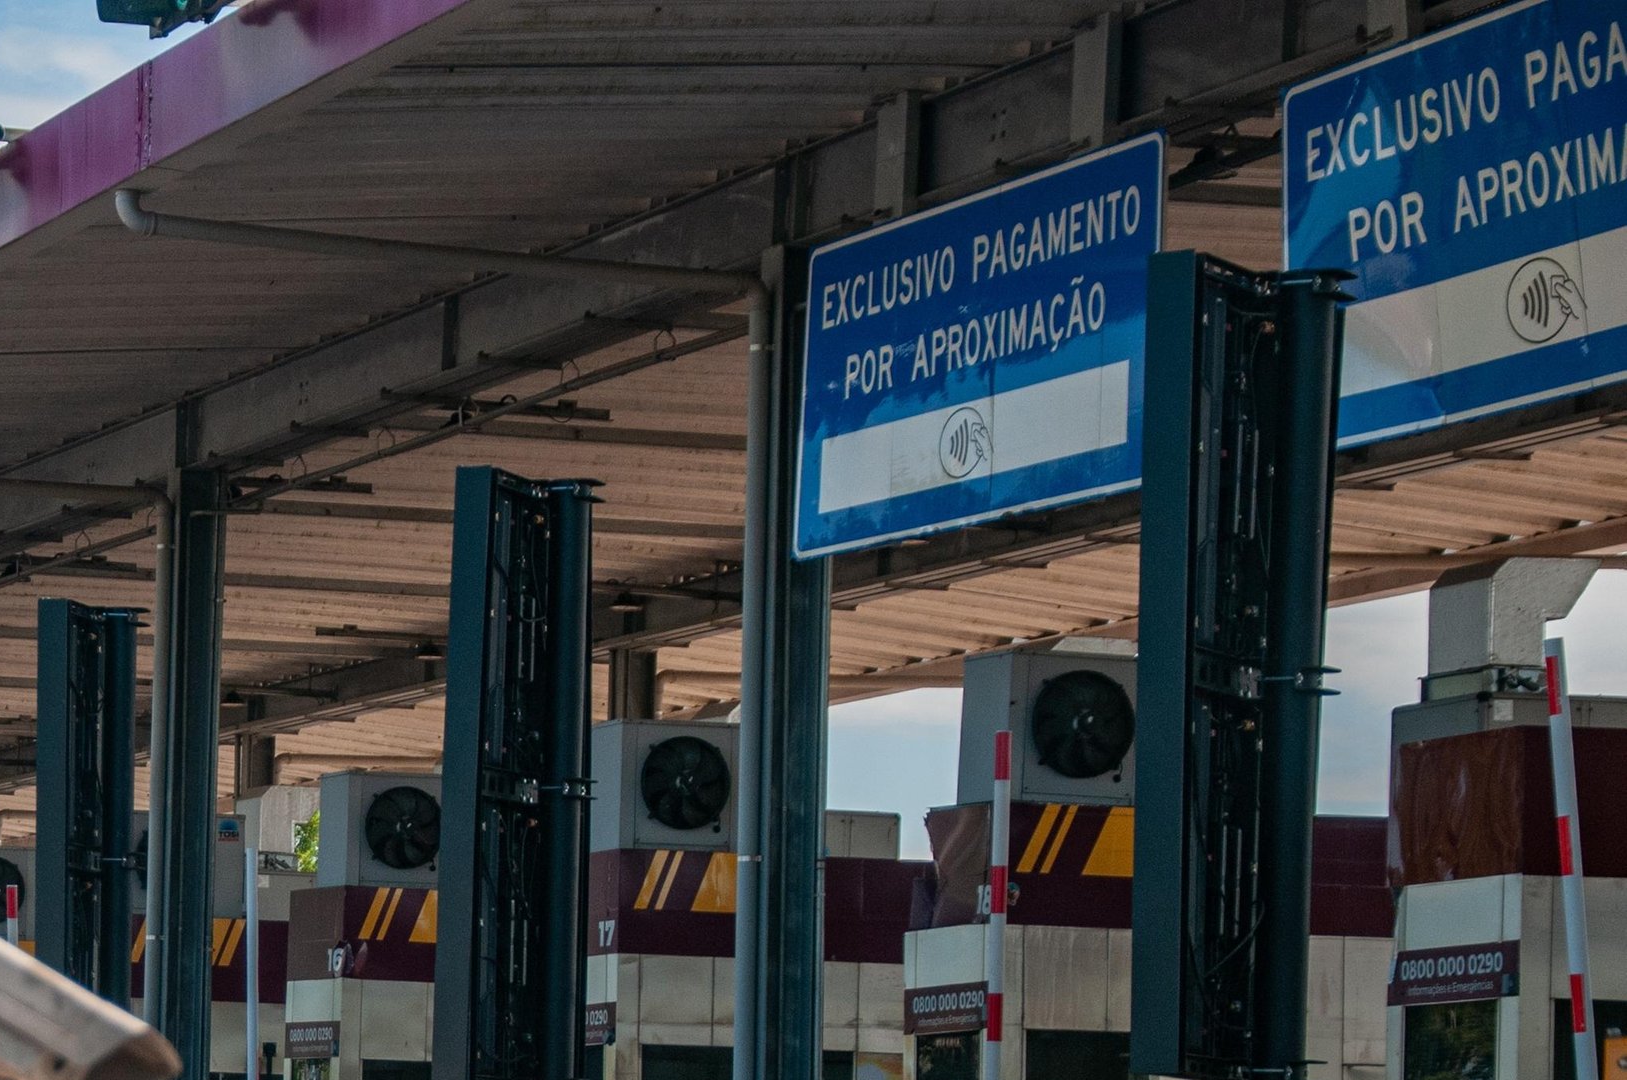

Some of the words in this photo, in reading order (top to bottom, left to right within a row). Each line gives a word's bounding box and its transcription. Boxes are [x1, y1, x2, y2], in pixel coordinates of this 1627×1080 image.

[1305, 66, 1501, 183] EXCLUSIVO
[1348, 191, 1428, 263] POR
[1453, 123, 1627, 234] APROXIM
[821, 245, 956, 331] EXCLUSIVO
[971, 184, 1142, 284] PAGAMENTO
[844, 343, 894, 401] POR
[911, 274, 1107, 383] APROXIMAÇÃO
[976, 884, 991, 915] 18
[598, 919, 616, 948] 17
[1400, 958, 1435, 981] 0800
[1437, 954, 1465, 977] 000
[1468, 951, 1504, 975] 0290
[590, 1008, 608, 1026] 0290
[913, 996, 937, 1015] 0800
[938, 993, 957, 1011] 000
[959, 989, 985, 1009] 0290
